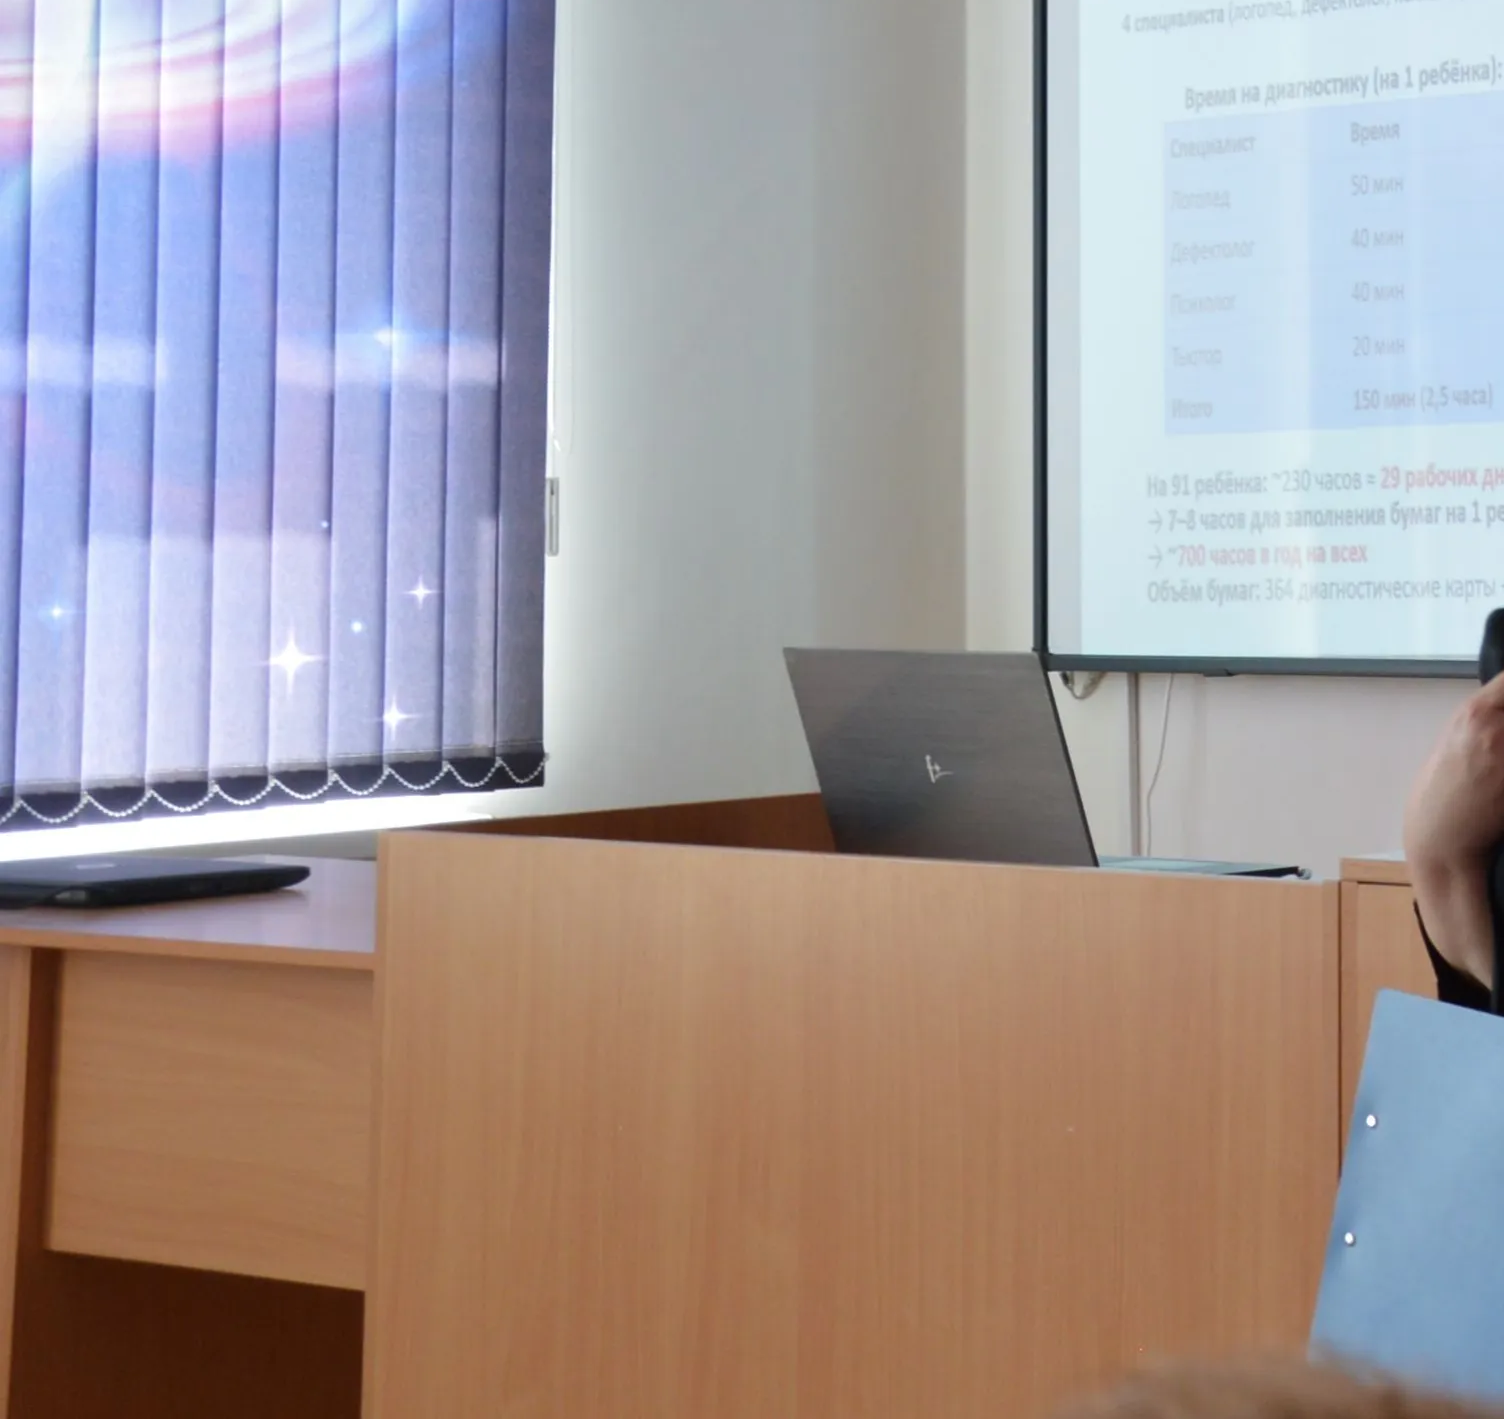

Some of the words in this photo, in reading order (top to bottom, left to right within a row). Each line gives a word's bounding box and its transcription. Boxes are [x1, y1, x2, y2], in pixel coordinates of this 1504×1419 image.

[1184, 86, 1236, 112] Время
[1241, 84, 1260, 103] на
[1264, 73, 1369, 107] диагностику
[1373, 65, 1400, 96] (на
[1404, 65, 1413, 88] 1
[1418, 53, 1503, 92] ребёнка):
[1350, 122, 1400, 145] Время
[1315, 471, 1362, 491] часов
[1380, 466, 1400, 489] 29
[1405, 462, 1478, 493] рабочих
[1200, 511, 1246, 530] часов
[1250, 510, 1281, 535] для
[1285, 506, 1385, 529] заполнения
[1390, 500, 1441, 529] бумаг
[1446, 504, 1466, 523] на
[1472, 499, 1481, 523] 1
[1210, 546, 1256, 565] часов
[1307, 545, 1327, 564] на
[1331, 544, 1368, 564] всех
[1297, 580, 1440, 605] диагностические
[1445, 578, 1495, 604] карты
